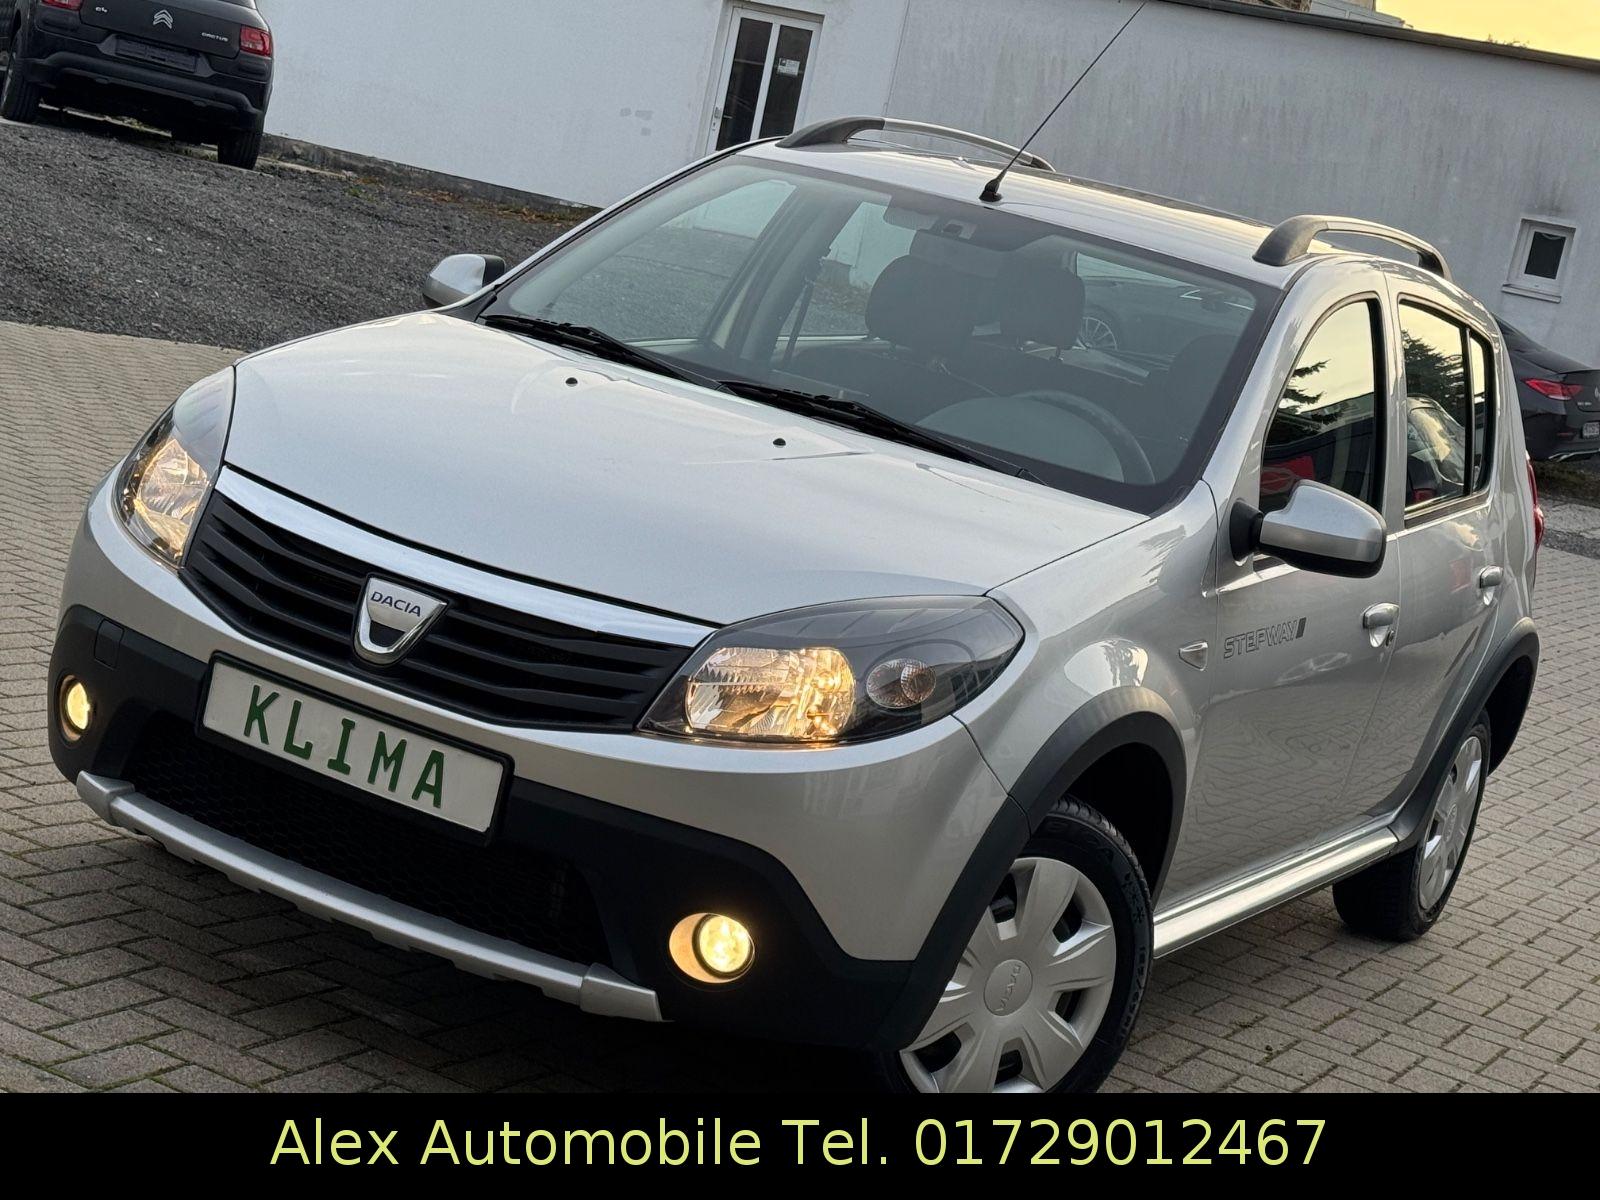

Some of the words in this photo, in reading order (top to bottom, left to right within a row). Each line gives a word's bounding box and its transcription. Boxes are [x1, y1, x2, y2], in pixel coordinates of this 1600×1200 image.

[370, 591, 421, 617] DACIA
[1223, 619, 1298, 659] STEPWAY
[243, 684, 445, 809] KLIMA
